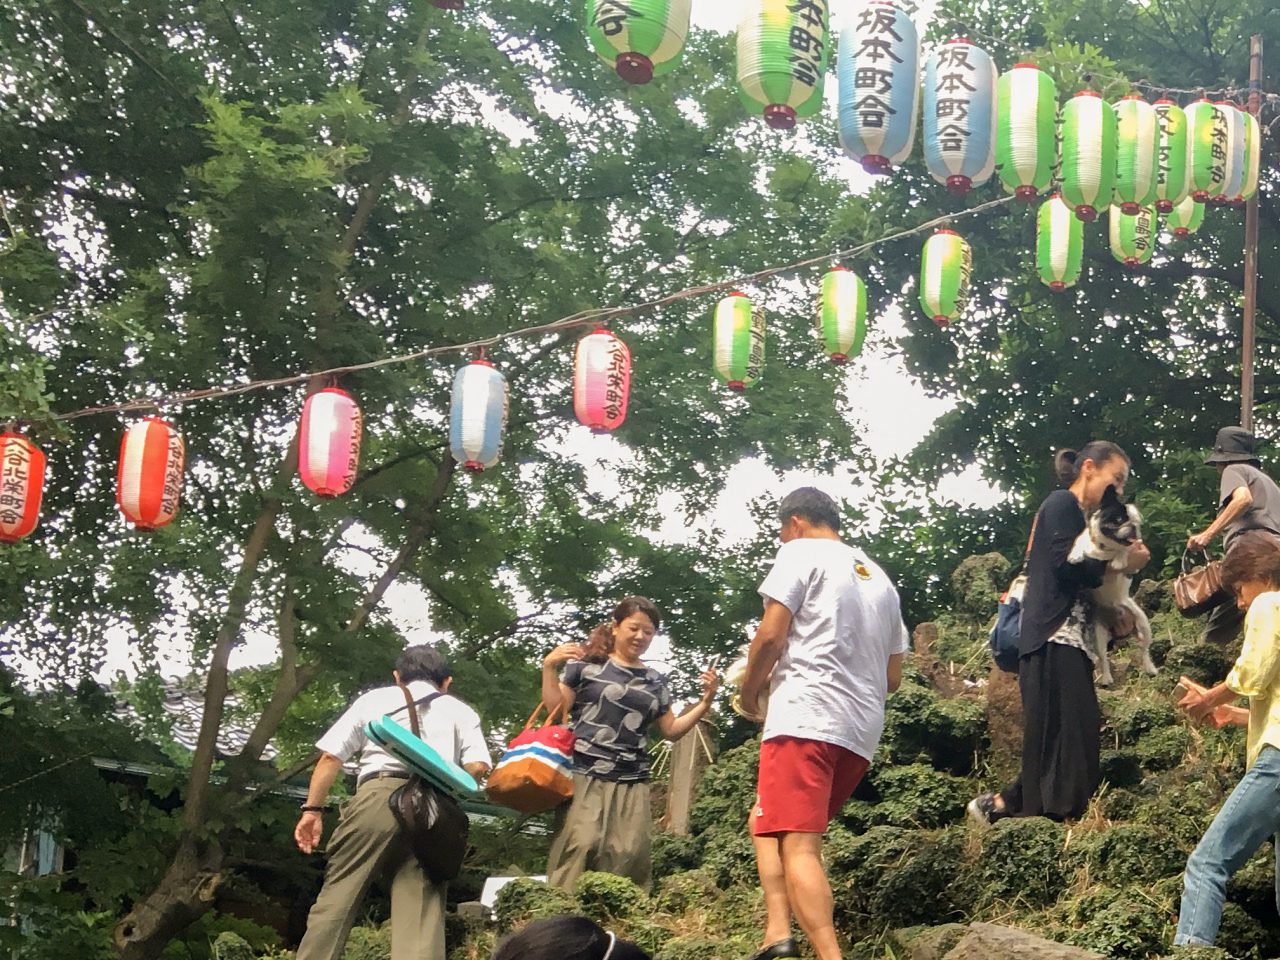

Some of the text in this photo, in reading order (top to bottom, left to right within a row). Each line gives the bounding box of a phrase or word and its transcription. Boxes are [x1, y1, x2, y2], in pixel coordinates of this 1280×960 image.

[853, 8, 902, 128] 坂本町会
[935, 46, 976, 152] 坂本町会
[603, 338, 628, 420] 入谷北栄町会
